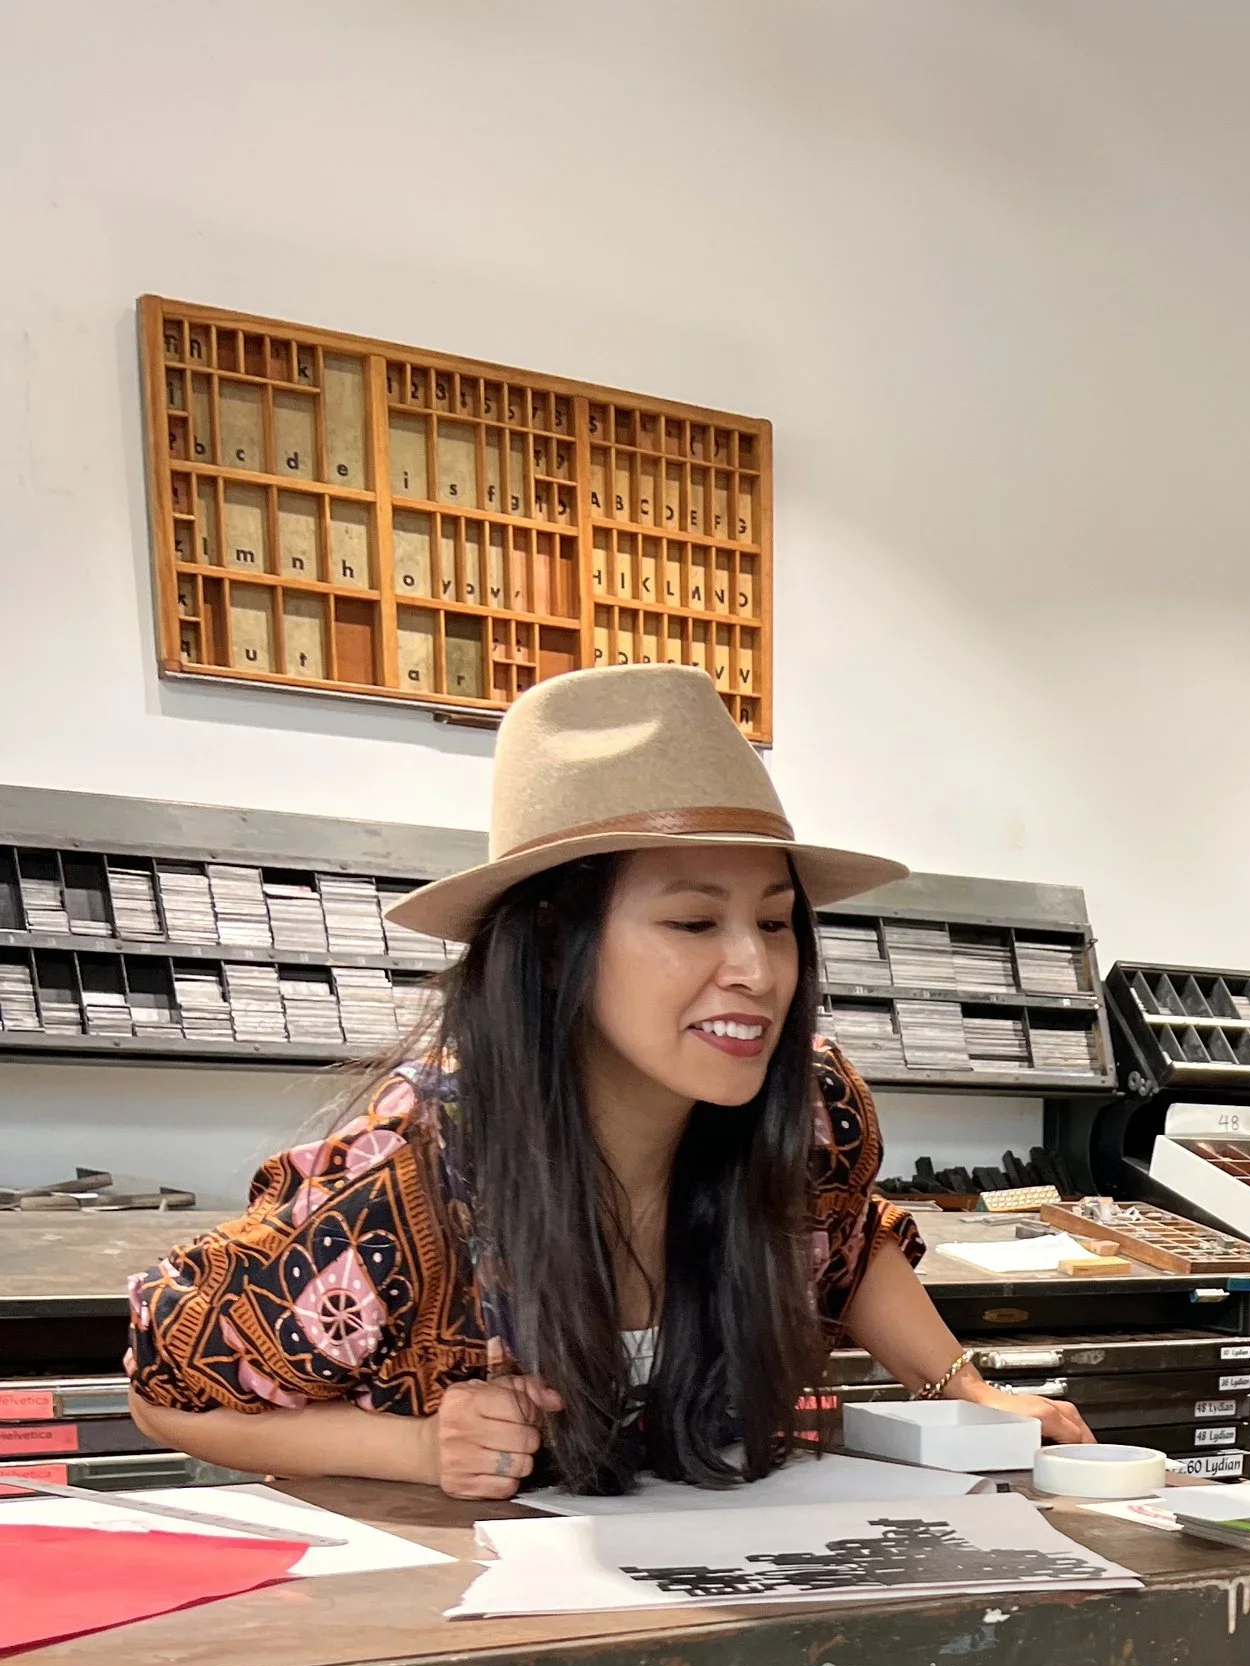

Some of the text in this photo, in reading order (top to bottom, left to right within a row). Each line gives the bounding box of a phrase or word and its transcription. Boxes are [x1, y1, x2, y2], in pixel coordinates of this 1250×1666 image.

[411, 379, 419, 399] 2
[435, 383, 447, 401] 3
[194, 435, 206, 455] b
[236, 449, 246, 461] c
[287, 451, 299, 470] d
[337, 463, 349, 476] e
[403, 471, 409, 489] i
[450, 483, 458, 496] s
[487, 485, 495, 503] f
[591, 491, 601, 508] A
[615, 495, 624, 511] B
[641, 498, 649, 515] C
[691, 510, 697, 526] E
[715, 515, 721, 530] F
[236, 548, 255, 562] m
[292, 556, 304, 571] n
[342, 559, 354, 578] h
[403, 575, 415, 586] o
[442, 580, 452, 594] y
[667, 580, 675, 596] L
[245, 648, 257, 661] u
[299, 652, 308, 666] t
[408, 669, 420, 681] a
[457, 675, 465, 686] r
[1218, 1114, 1240, 1131] 48
[1231, 1378, 1249, 1387] Lydian
[1197, 1402, 1234, 1414] 48 Lydian
[1197, 1430, 1234, 1443] 48 Lydian
[1187, 1460, 1202, 1474] 60
[1205, 1457, 1241, 1476] Lydian
